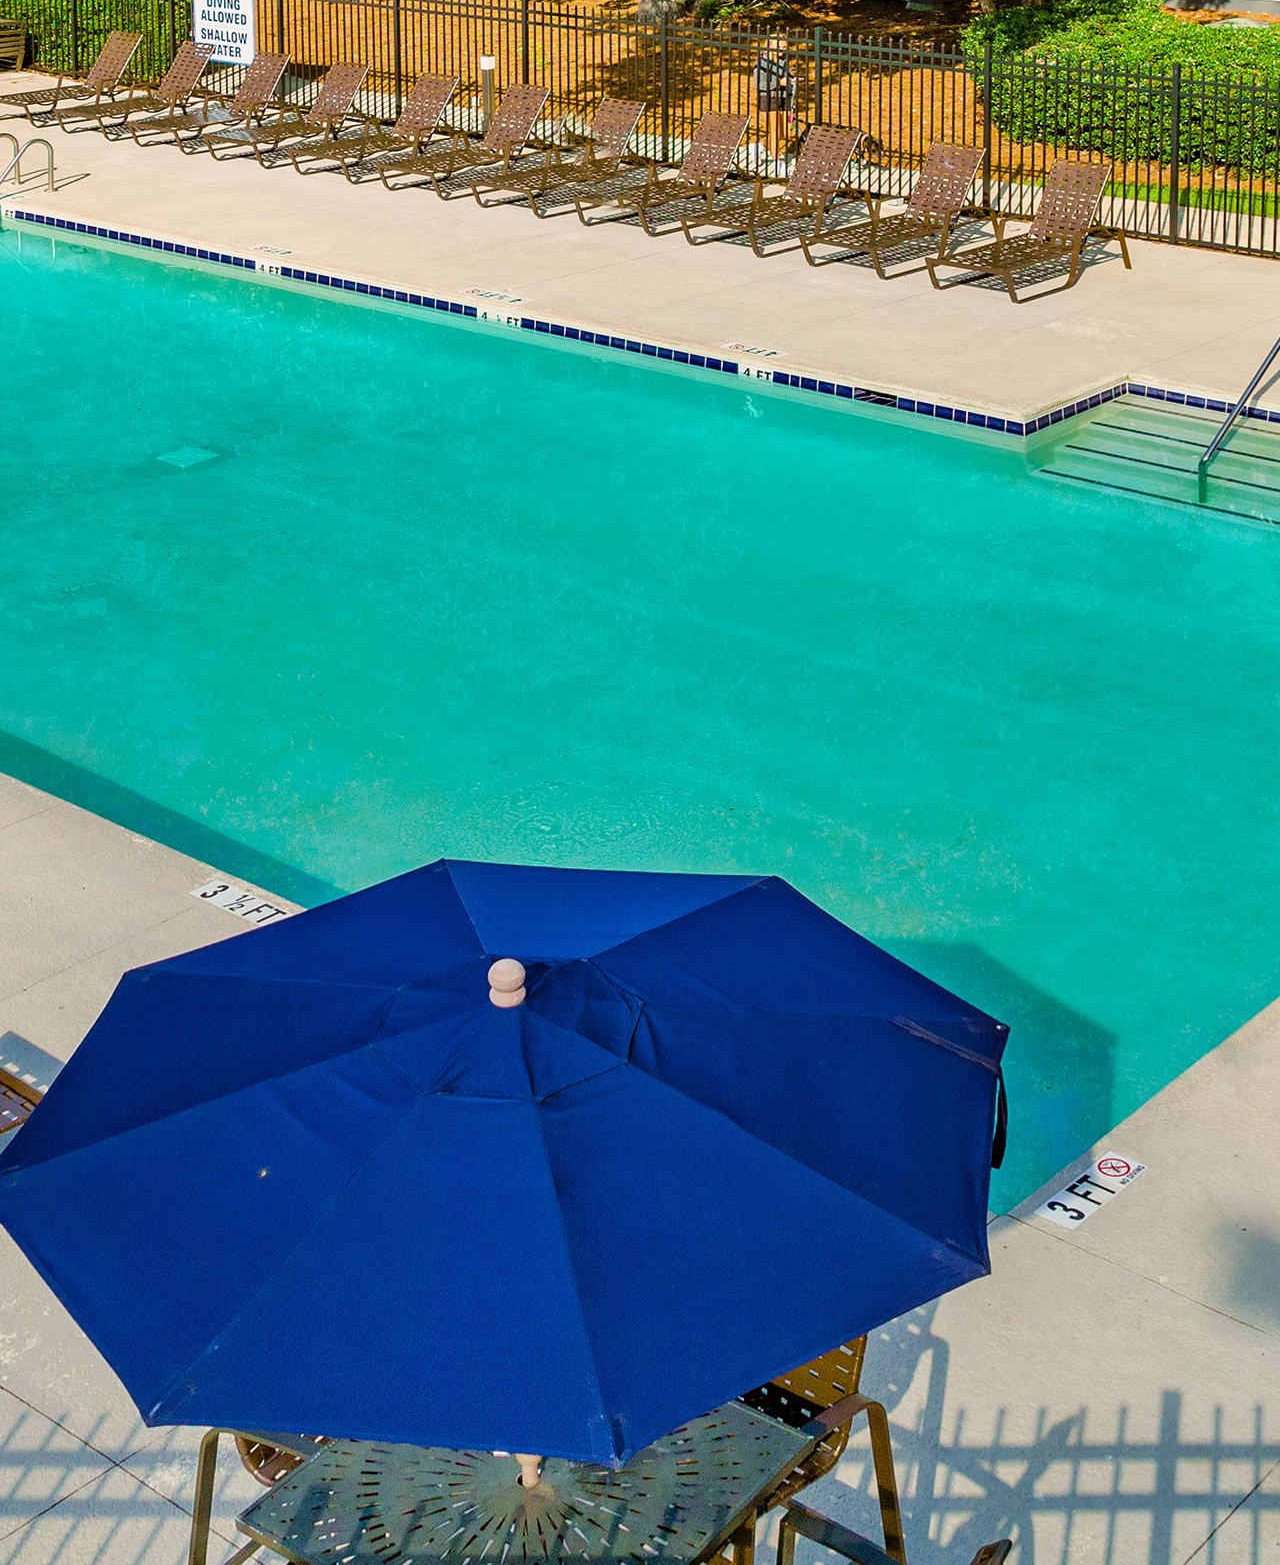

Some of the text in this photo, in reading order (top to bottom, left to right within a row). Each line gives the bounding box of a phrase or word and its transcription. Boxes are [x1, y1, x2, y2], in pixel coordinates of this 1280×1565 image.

[201, 9, 247, 25] ALLOWED
[200, 27, 248, 44] SHALLOW
[216, 44, 242, 58] ATER
[268, 265, 280, 274] FT
[481, 311, 488, 320] 4
[506, 316, 520, 326] FT
[743, 367, 771, 381] 4 FT
[200, 884, 230, 899] 3
[241, 903, 288, 924] FT
[1046, 1173, 1117, 1221] 3 FT
